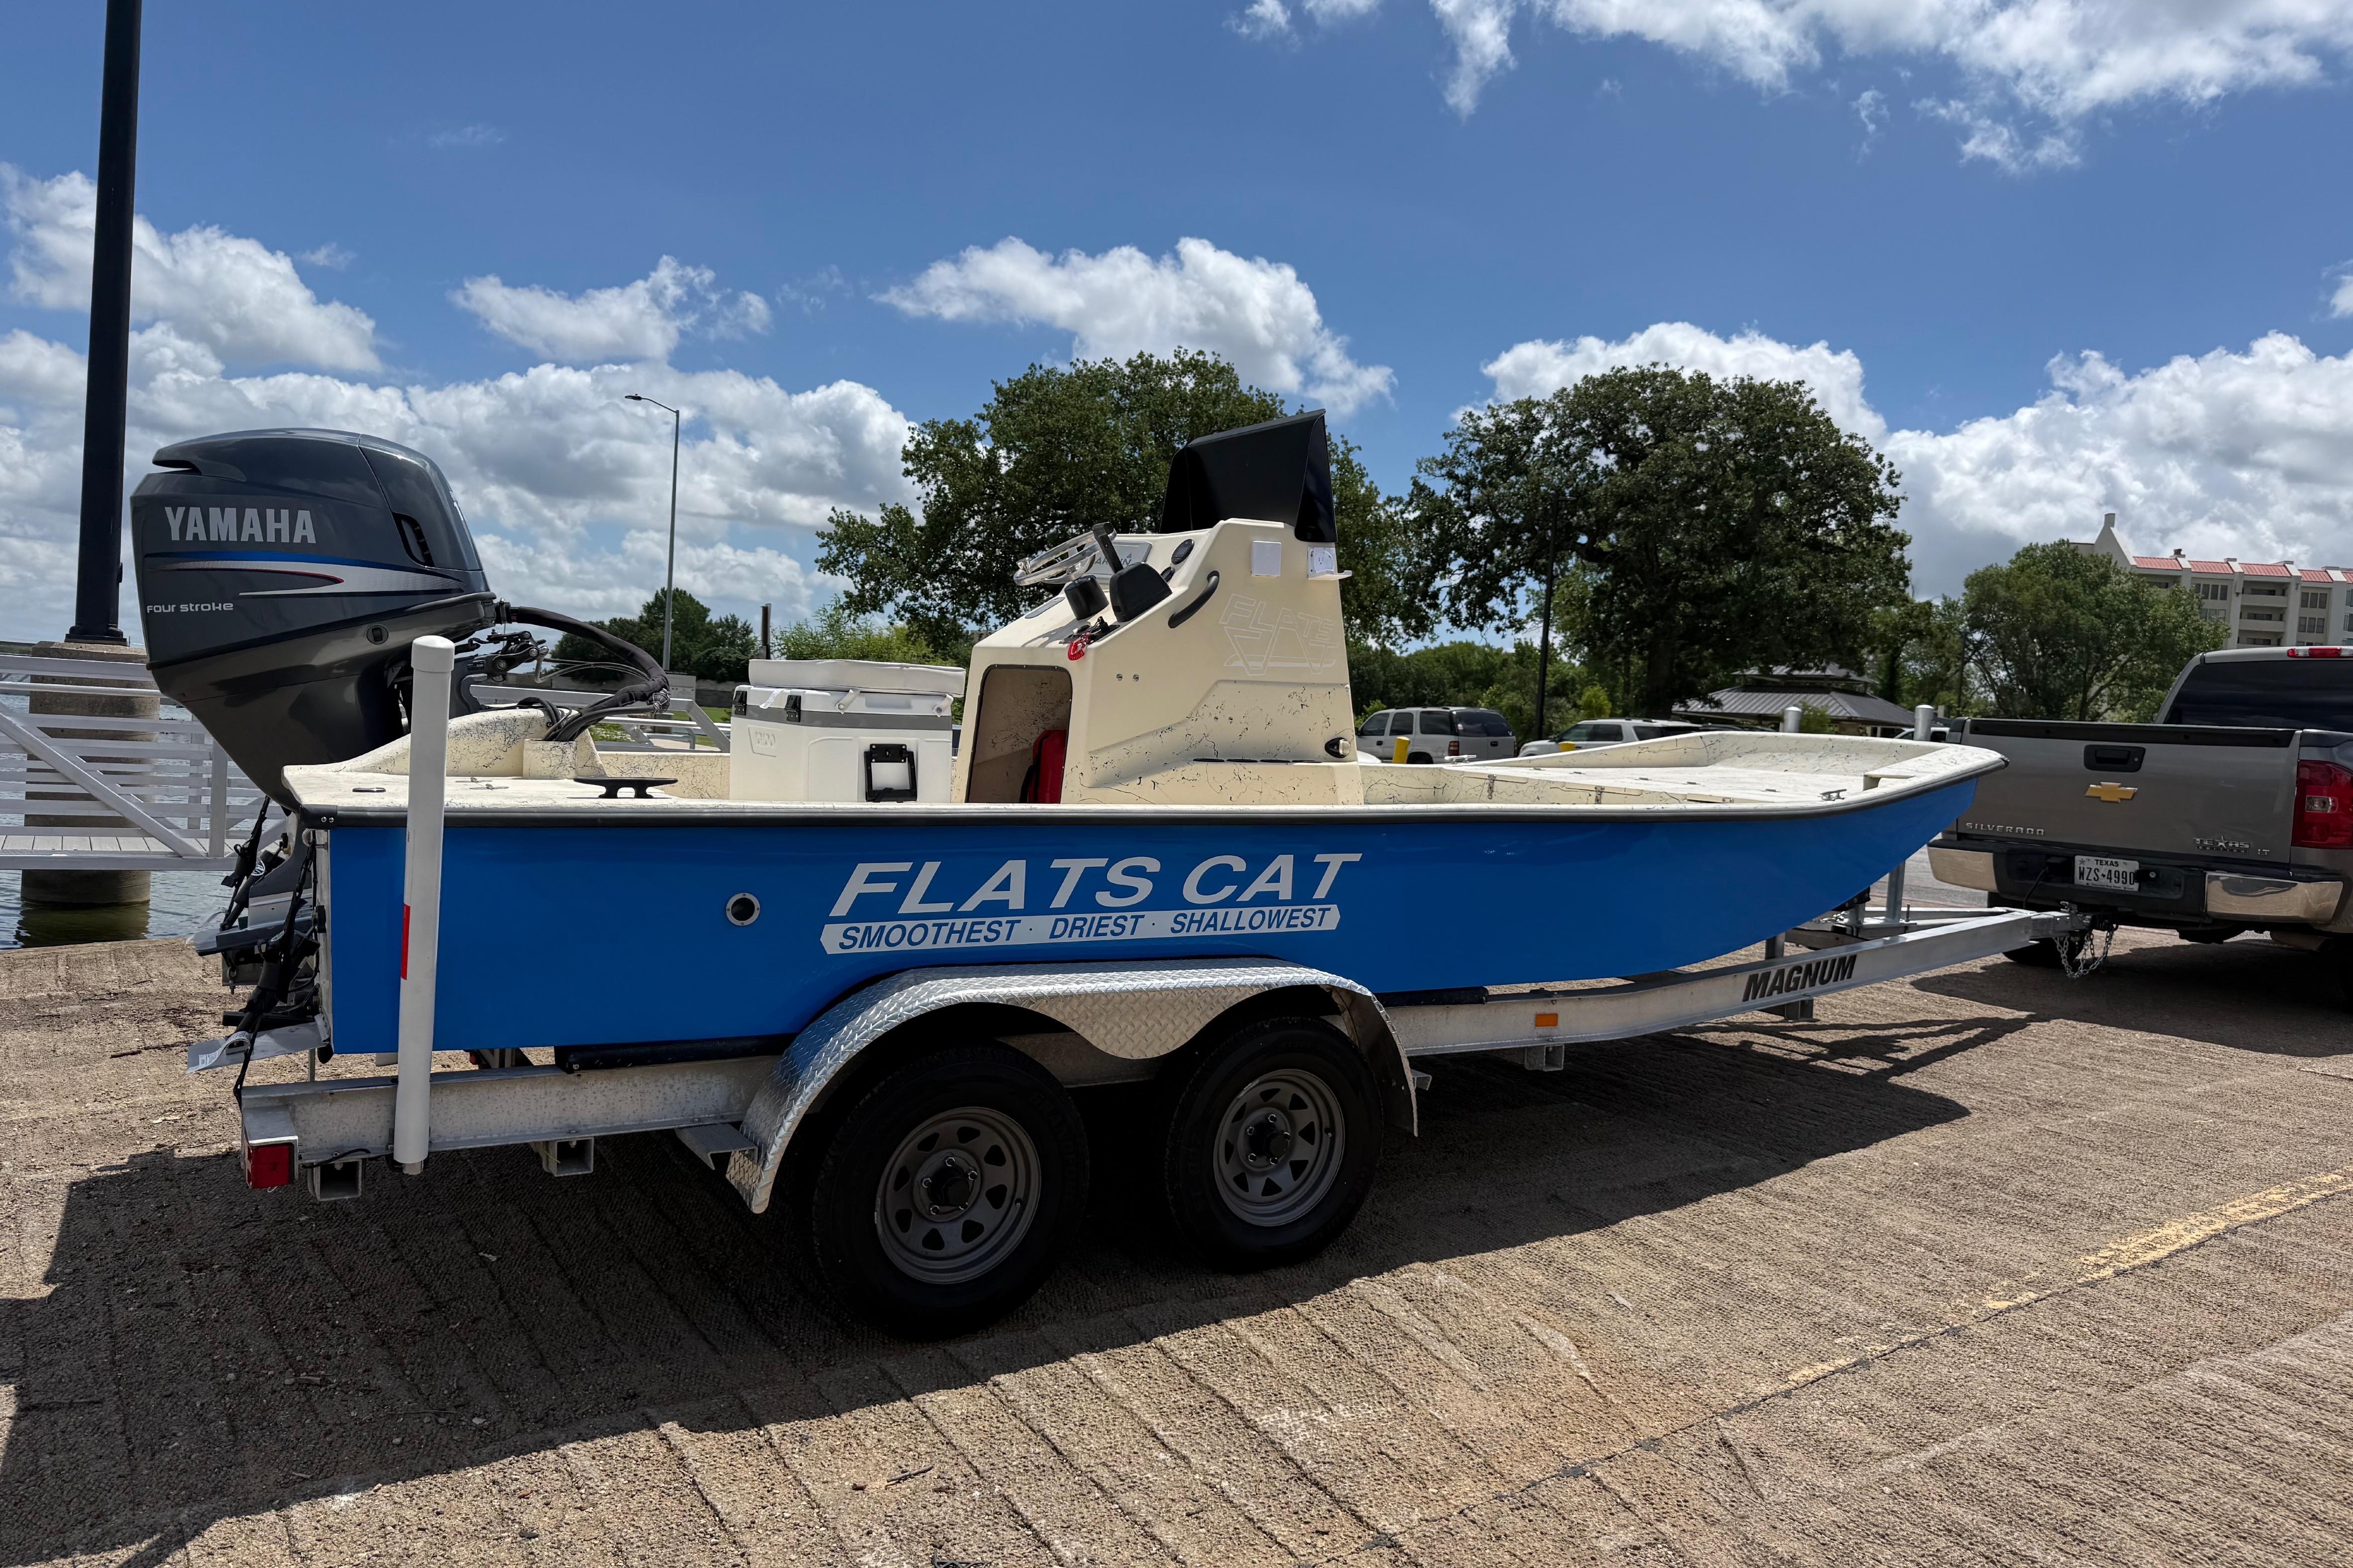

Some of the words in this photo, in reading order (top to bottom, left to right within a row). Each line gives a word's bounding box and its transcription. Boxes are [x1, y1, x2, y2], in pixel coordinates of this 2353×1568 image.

[165, 506, 316, 543] YAMAHA
[1219, 593, 1335, 641] FLATS
[1966, 822, 2045, 835] SILVERADO
[2193, 836, 2250, 849] TEXAS
[2094, 859, 2119, 867] TEXAS
[828, 856, 1161, 917] FLATS
[1183, 853, 1363, 904] CAT
[839, 919, 1022, 950] SMOOTHEST
[1048, 914, 1145, 939] DRIEST
[1170, 907, 1331, 934] SHALLOWEST
[1742, 954, 1857, 1002] MAGNUM
